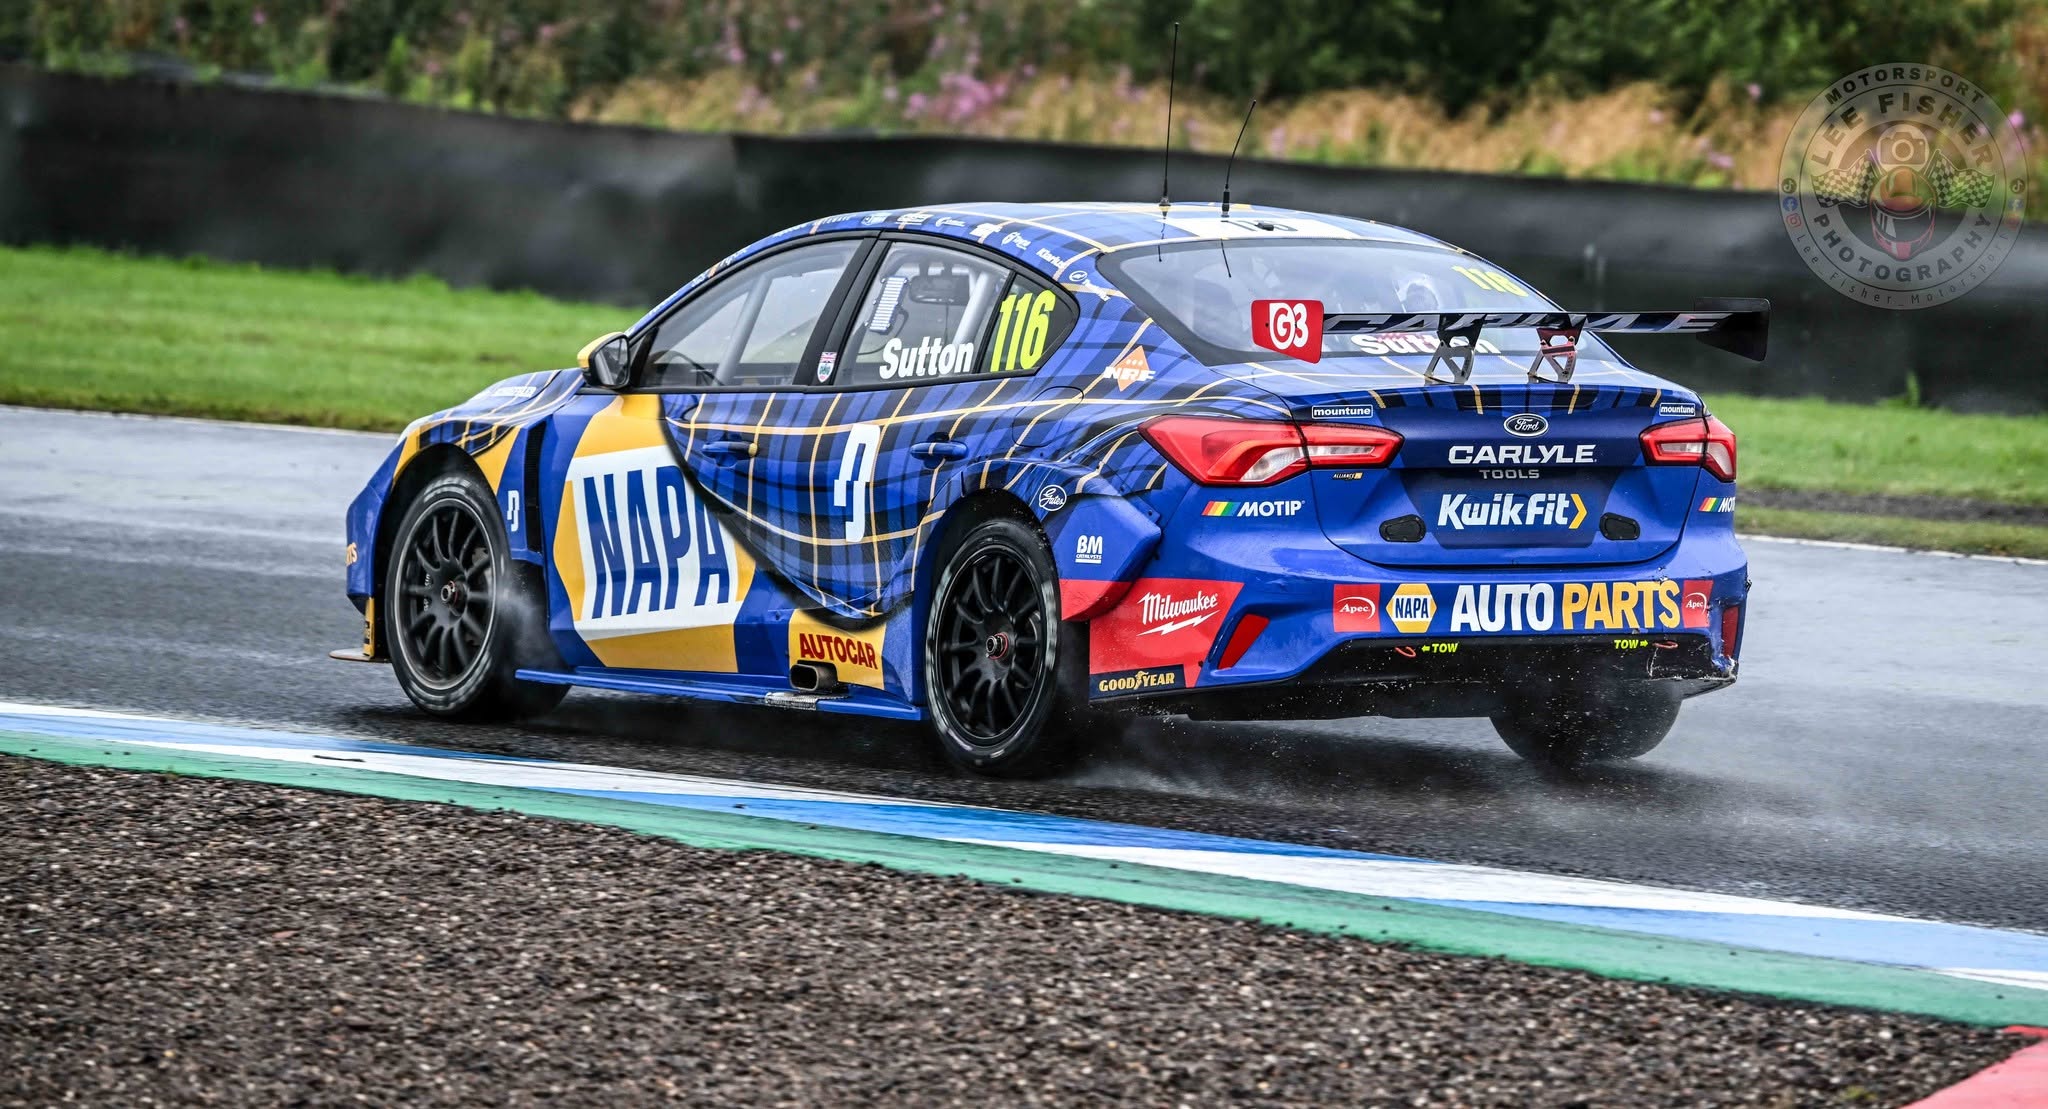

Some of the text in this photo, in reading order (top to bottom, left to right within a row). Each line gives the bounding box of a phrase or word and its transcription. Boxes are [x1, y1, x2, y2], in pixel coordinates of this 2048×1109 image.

[990, 290, 1056, 372] 116
[1269, 303, 1309, 350] G3
[879, 338, 975, 380] Sutton
[1103, 366, 1157, 381] NRF
[1313, 406, 1371, 417] mountune
[1660, 404, 1695, 415] mountune
[1514, 417, 1540, 431] Ford
[1448, 444, 1595, 464] CARLYLE
[1479, 469, 1540, 479] TOOLS
[1236, 500, 1302, 517] MOTIP
[584, 465, 731, 619] NAPA
[1076, 534, 1103, 555] BM
[1137, 591, 1218, 625] Milwaukee
[1339, 602, 1370, 616] Apec
[1395, 597, 1429, 619] NAPA
[1450, 580, 1681, 631] AUTO PARTS
[1685, 599, 1704, 609] Apec
[799, 632, 878, 670] AUTOCAR
[1431, 643, 1458, 653] TOW
[1613, 639, 1639, 649] TOW
